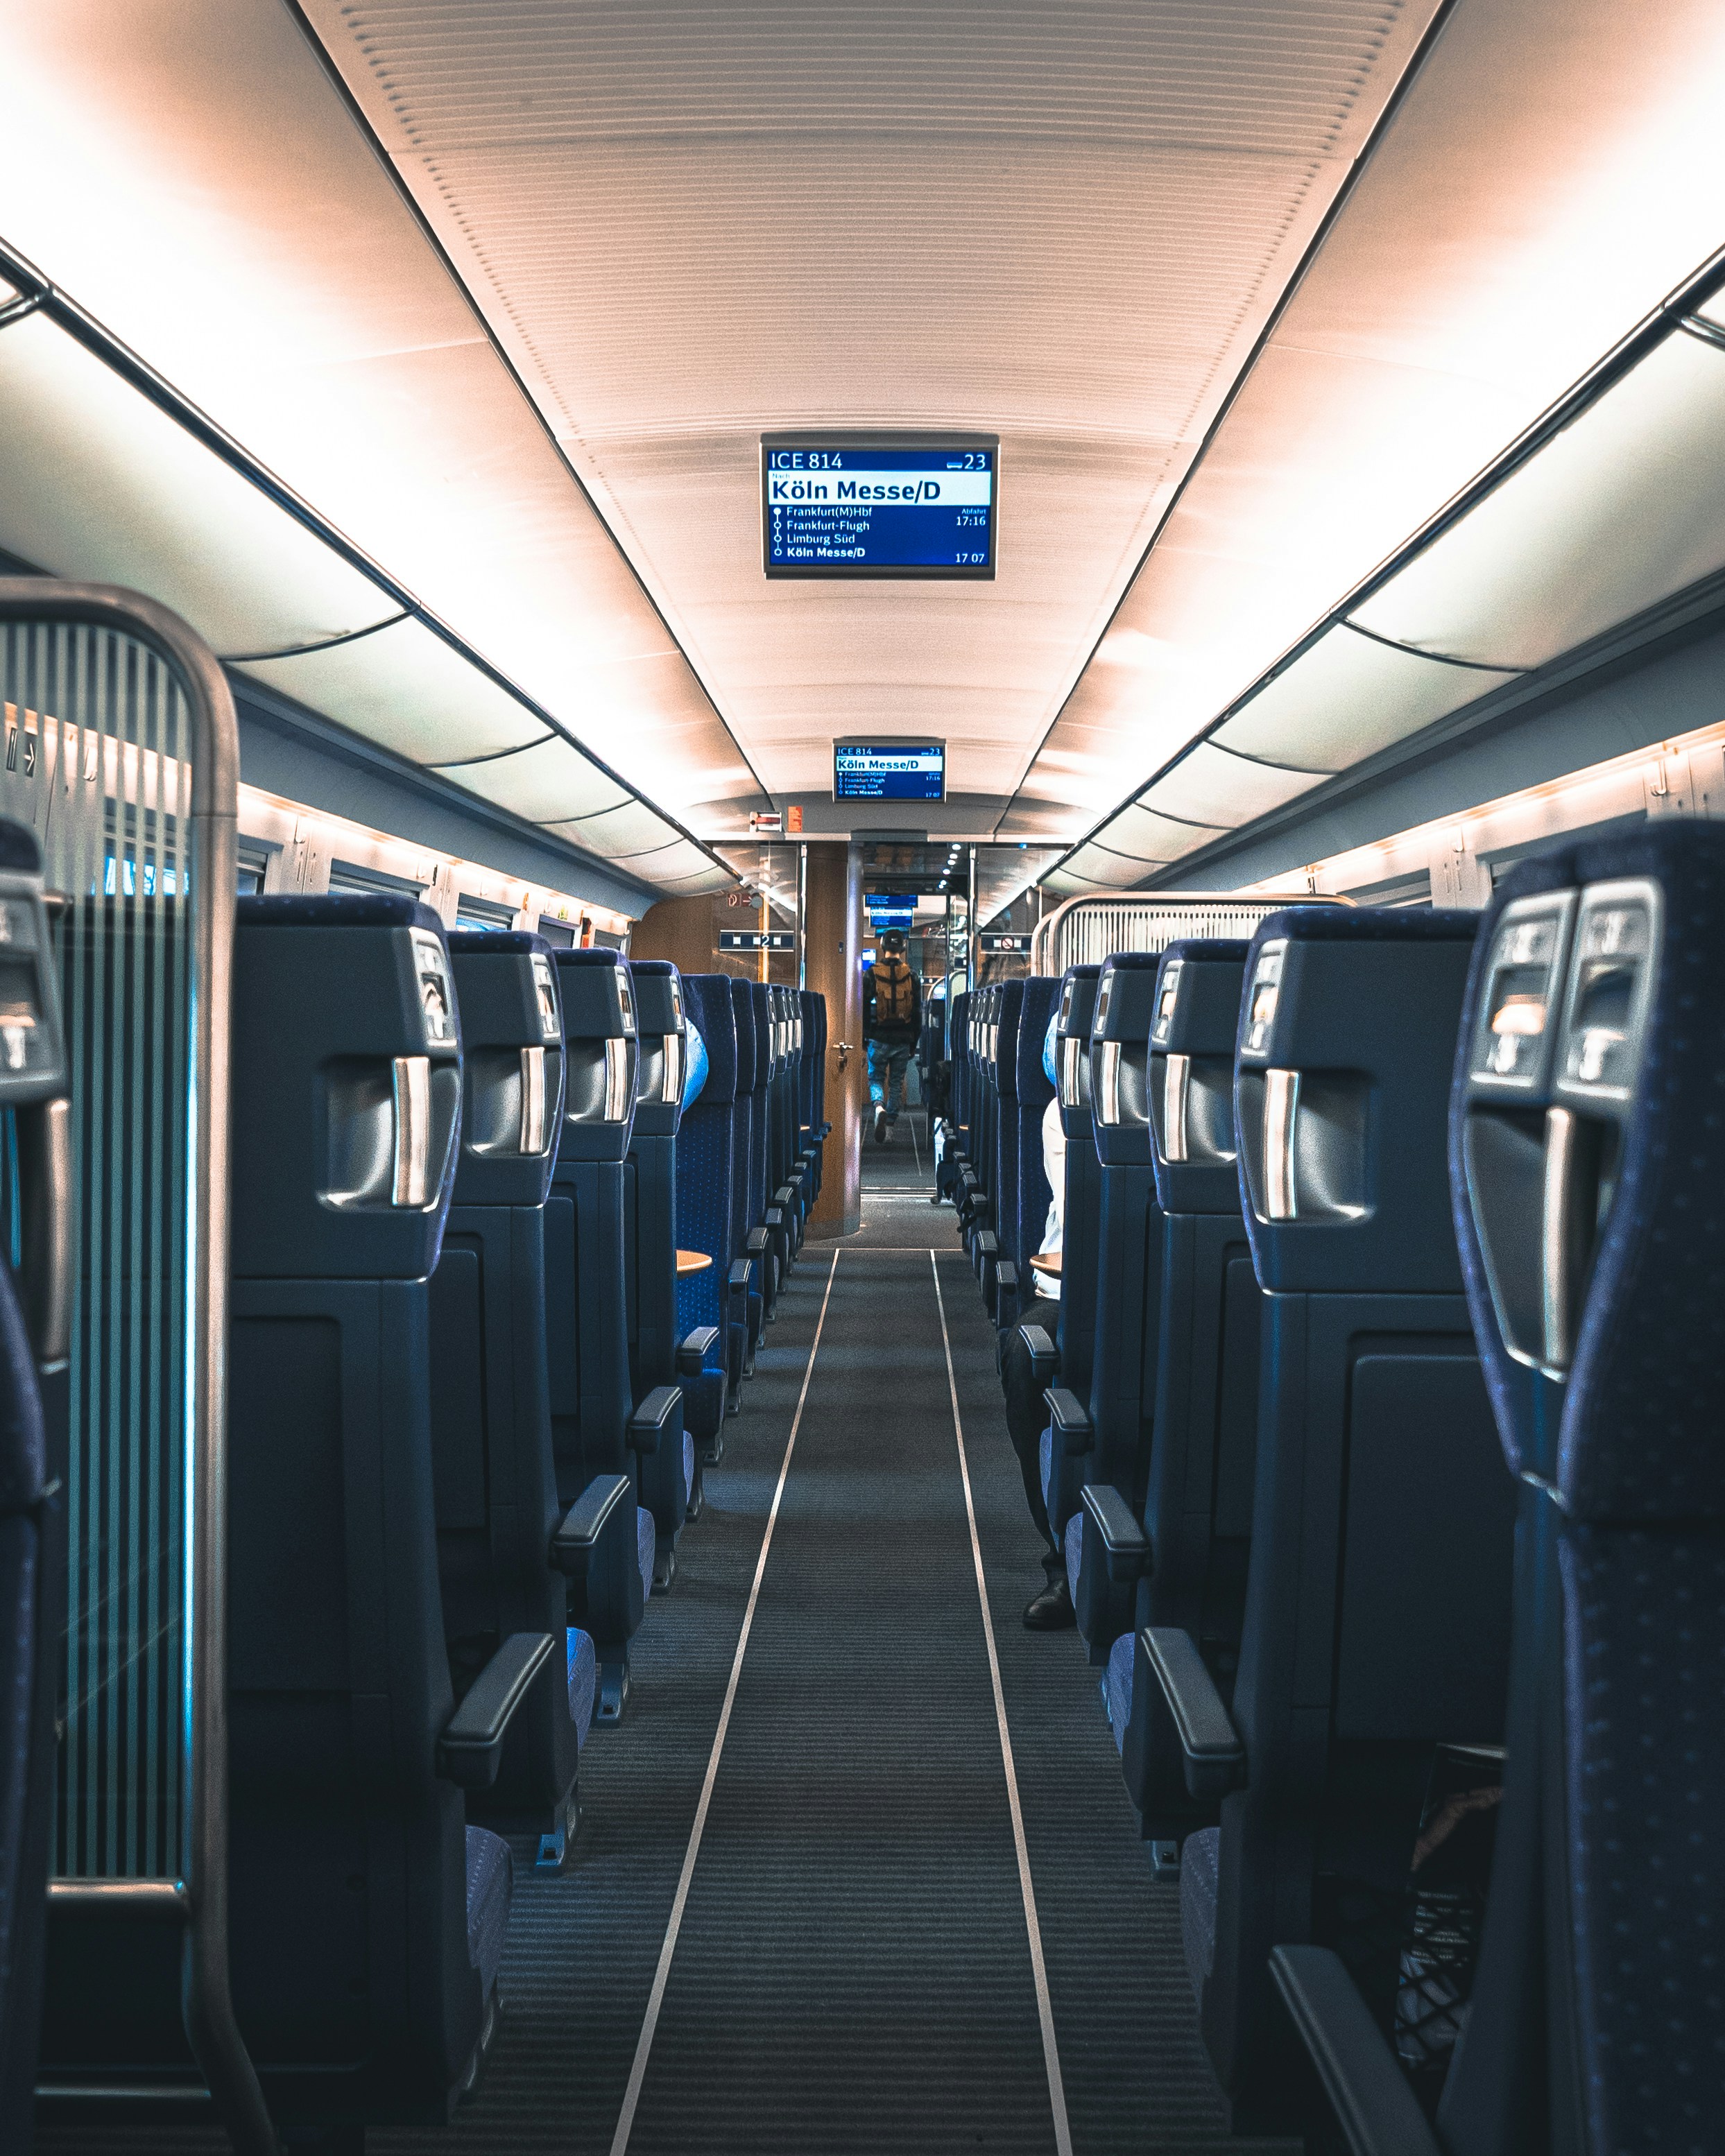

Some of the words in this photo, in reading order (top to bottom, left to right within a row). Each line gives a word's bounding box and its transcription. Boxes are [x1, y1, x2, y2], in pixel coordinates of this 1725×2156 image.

[771, 453, 804, 469] ICE
[809, 453, 843, 469] 814
[963, 454, 986, 469] 23
[773, 480, 828, 500] Köln
[836, 480, 941, 504] Messe/D
[787, 506, 873, 518] Frankfurt(M)Hbf
[787, 521, 870, 531] Frankfurt-Flugh
[956, 516, 986, 526] 17:16
[787, 534, 830, 545] Limburg
[834, 534, 855, 544] Süd
[787, 546, 814, 558] Köln
[817, 547, 866, 558] Messe/D
[838, 748, 854, 756] ICE
[855, 748, 872, 756] 814
[929, 748, 941, 756] 23
[838, 759, 865, 769] Köln
[869, 759, 919, 770] Messe/D
[761, 935, 770, 947] 2
